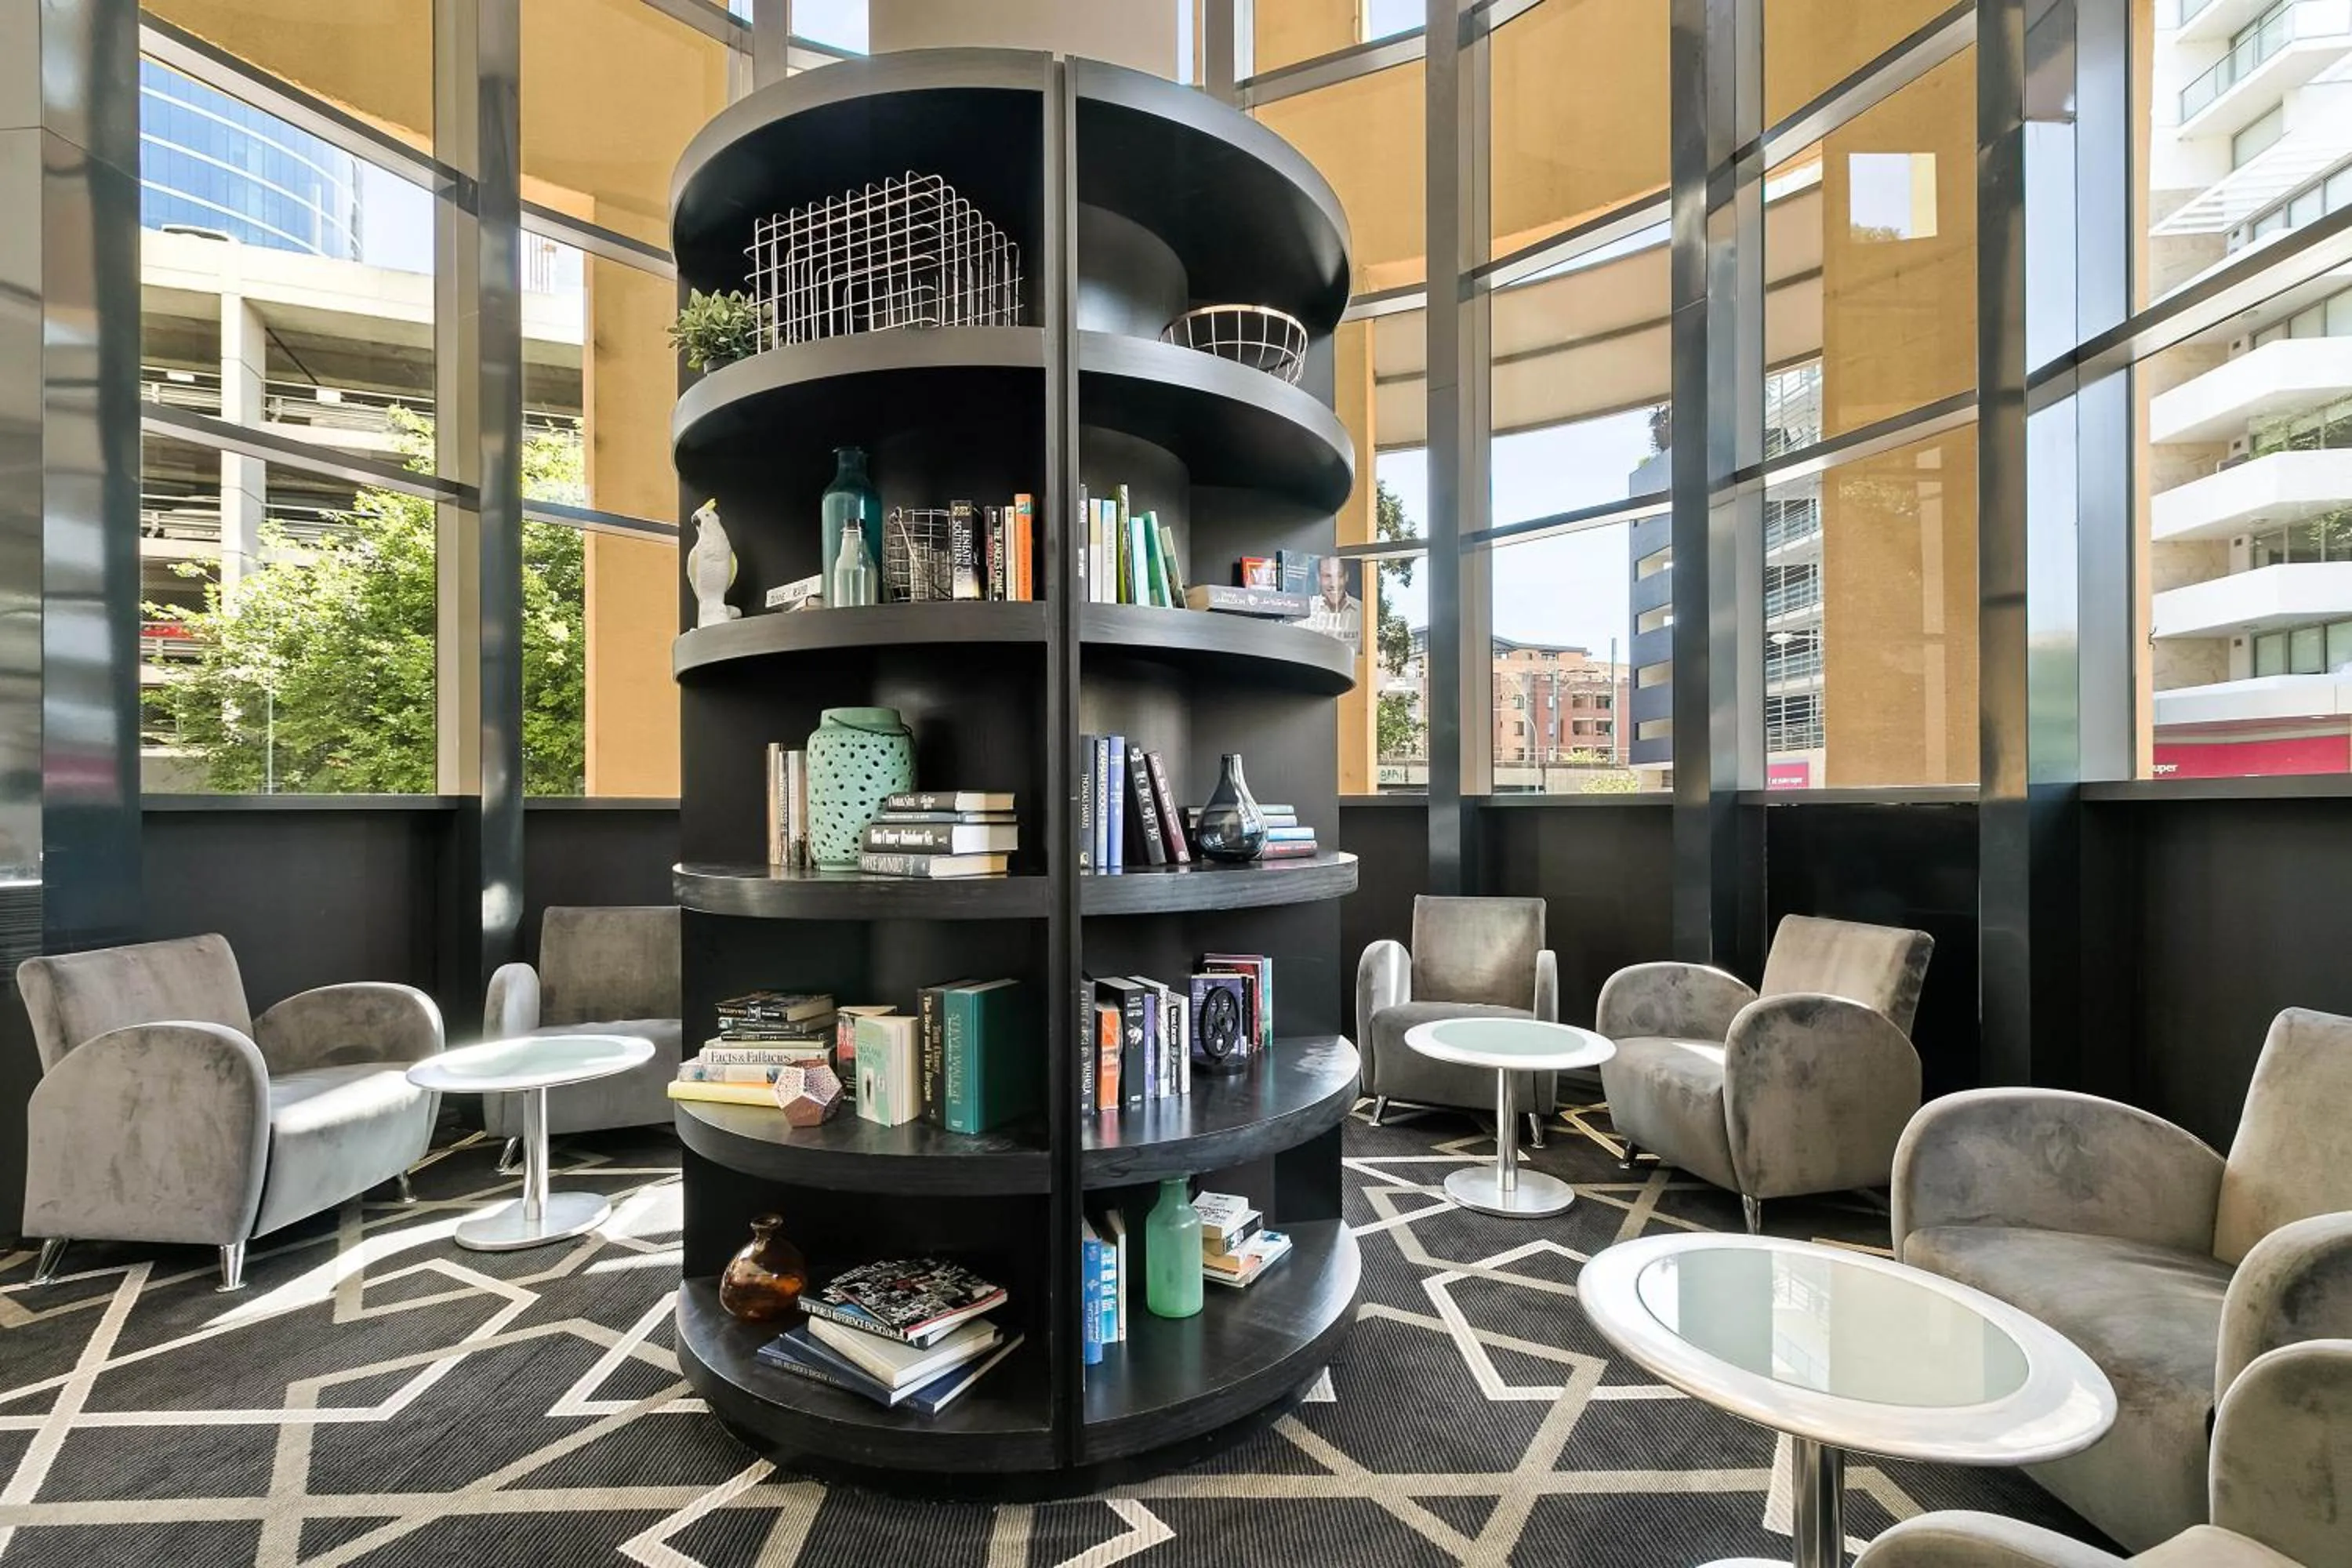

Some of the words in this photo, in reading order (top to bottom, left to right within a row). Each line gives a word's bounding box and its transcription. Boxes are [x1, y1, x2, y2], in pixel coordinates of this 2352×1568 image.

[953, 520, 963, 564] SOUTHERN
[962, 529, 971, 565] BENEATH
[924, 995, 932, 1012] The
[950, 1013, 960, 1053] STEVE
[710, 1050, 737, 1063] Facts
[746, 1050, 791, 1064] Fallacies
[951, 1055, 962, 1105] WAUGH
